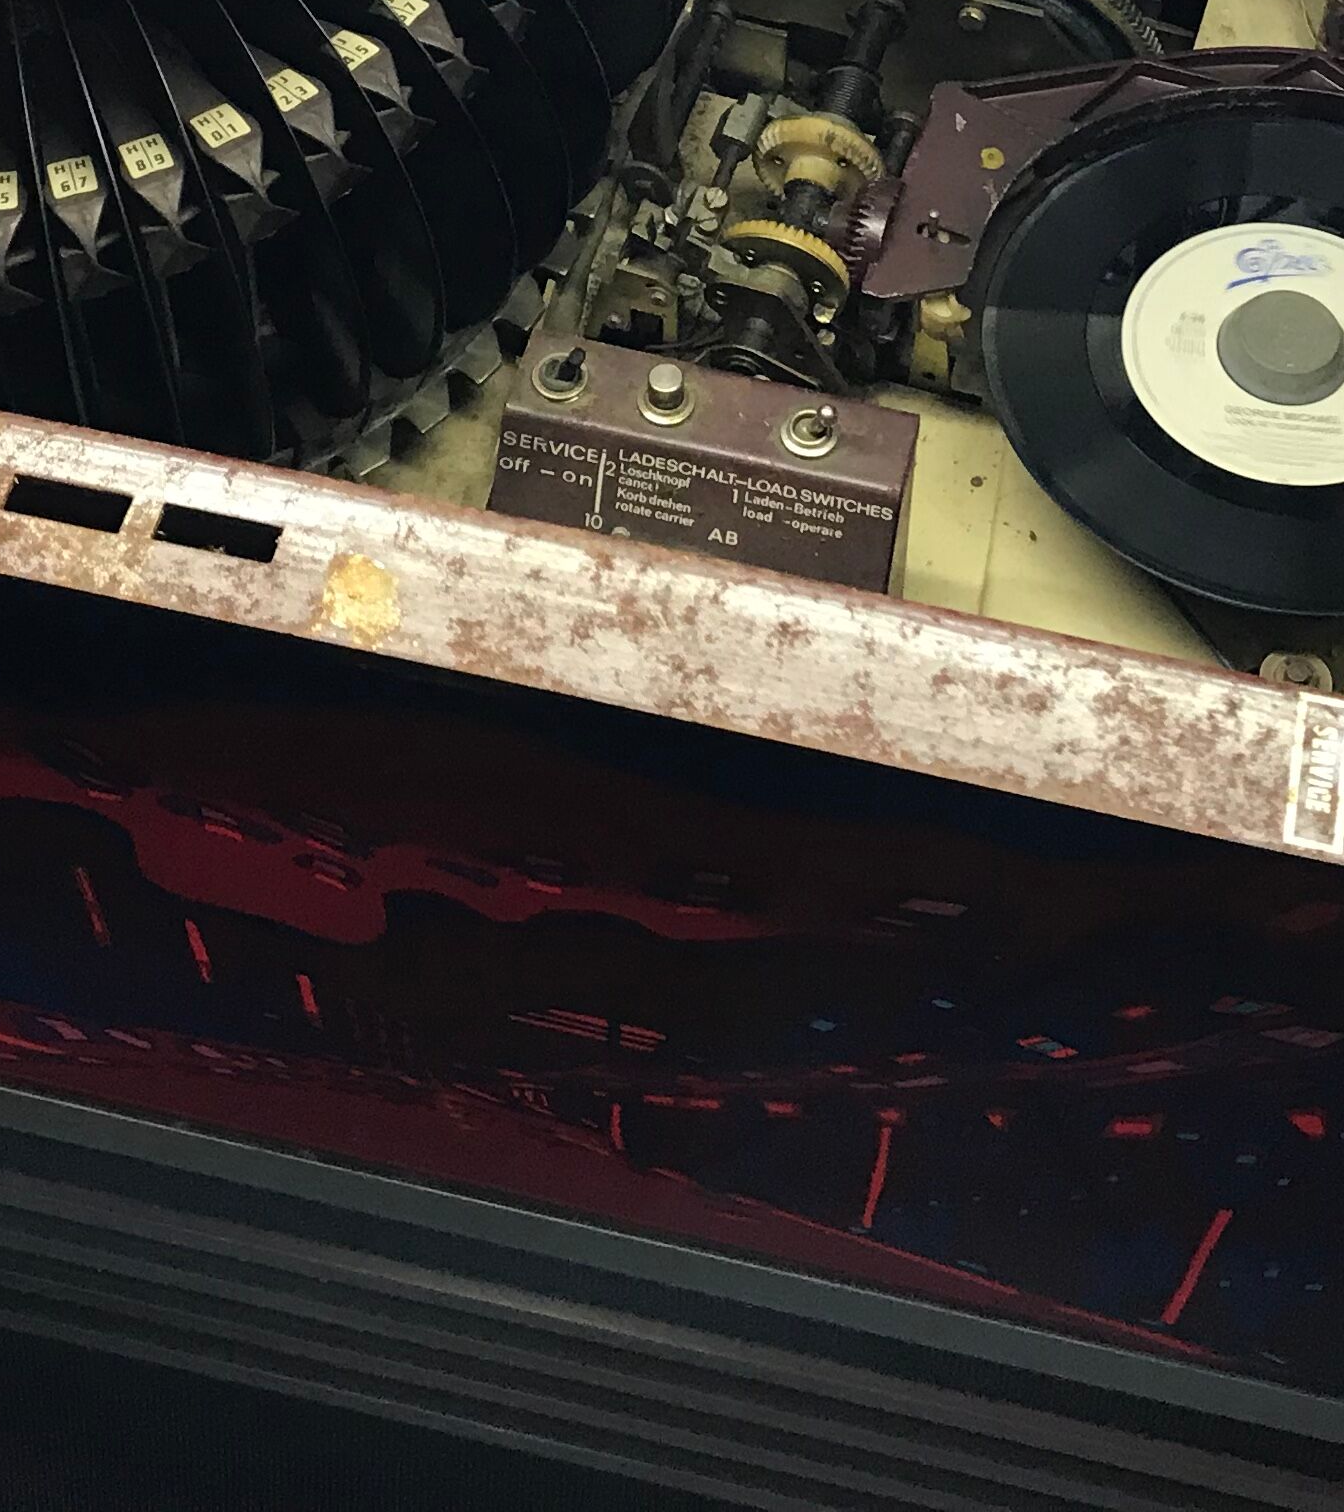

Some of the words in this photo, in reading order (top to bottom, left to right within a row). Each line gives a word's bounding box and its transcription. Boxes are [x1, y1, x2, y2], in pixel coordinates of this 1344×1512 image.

[503, 430, 599, 463] SERVICE
[606, 461, 616, 477] 2
[562, 471, 593, 488] on
[617, 488, 646, 504] Korb
[649, 493, 691, 514] drehen
[732, 489, 738, 504] 1
[615, 501, 652, 518] rotate
[655, 510, 695, 527] carrier
[743, 506, 773, 523] load
[707, 527, 738, 545] AB
[1305, 724, 1339, 814] SERVICE
